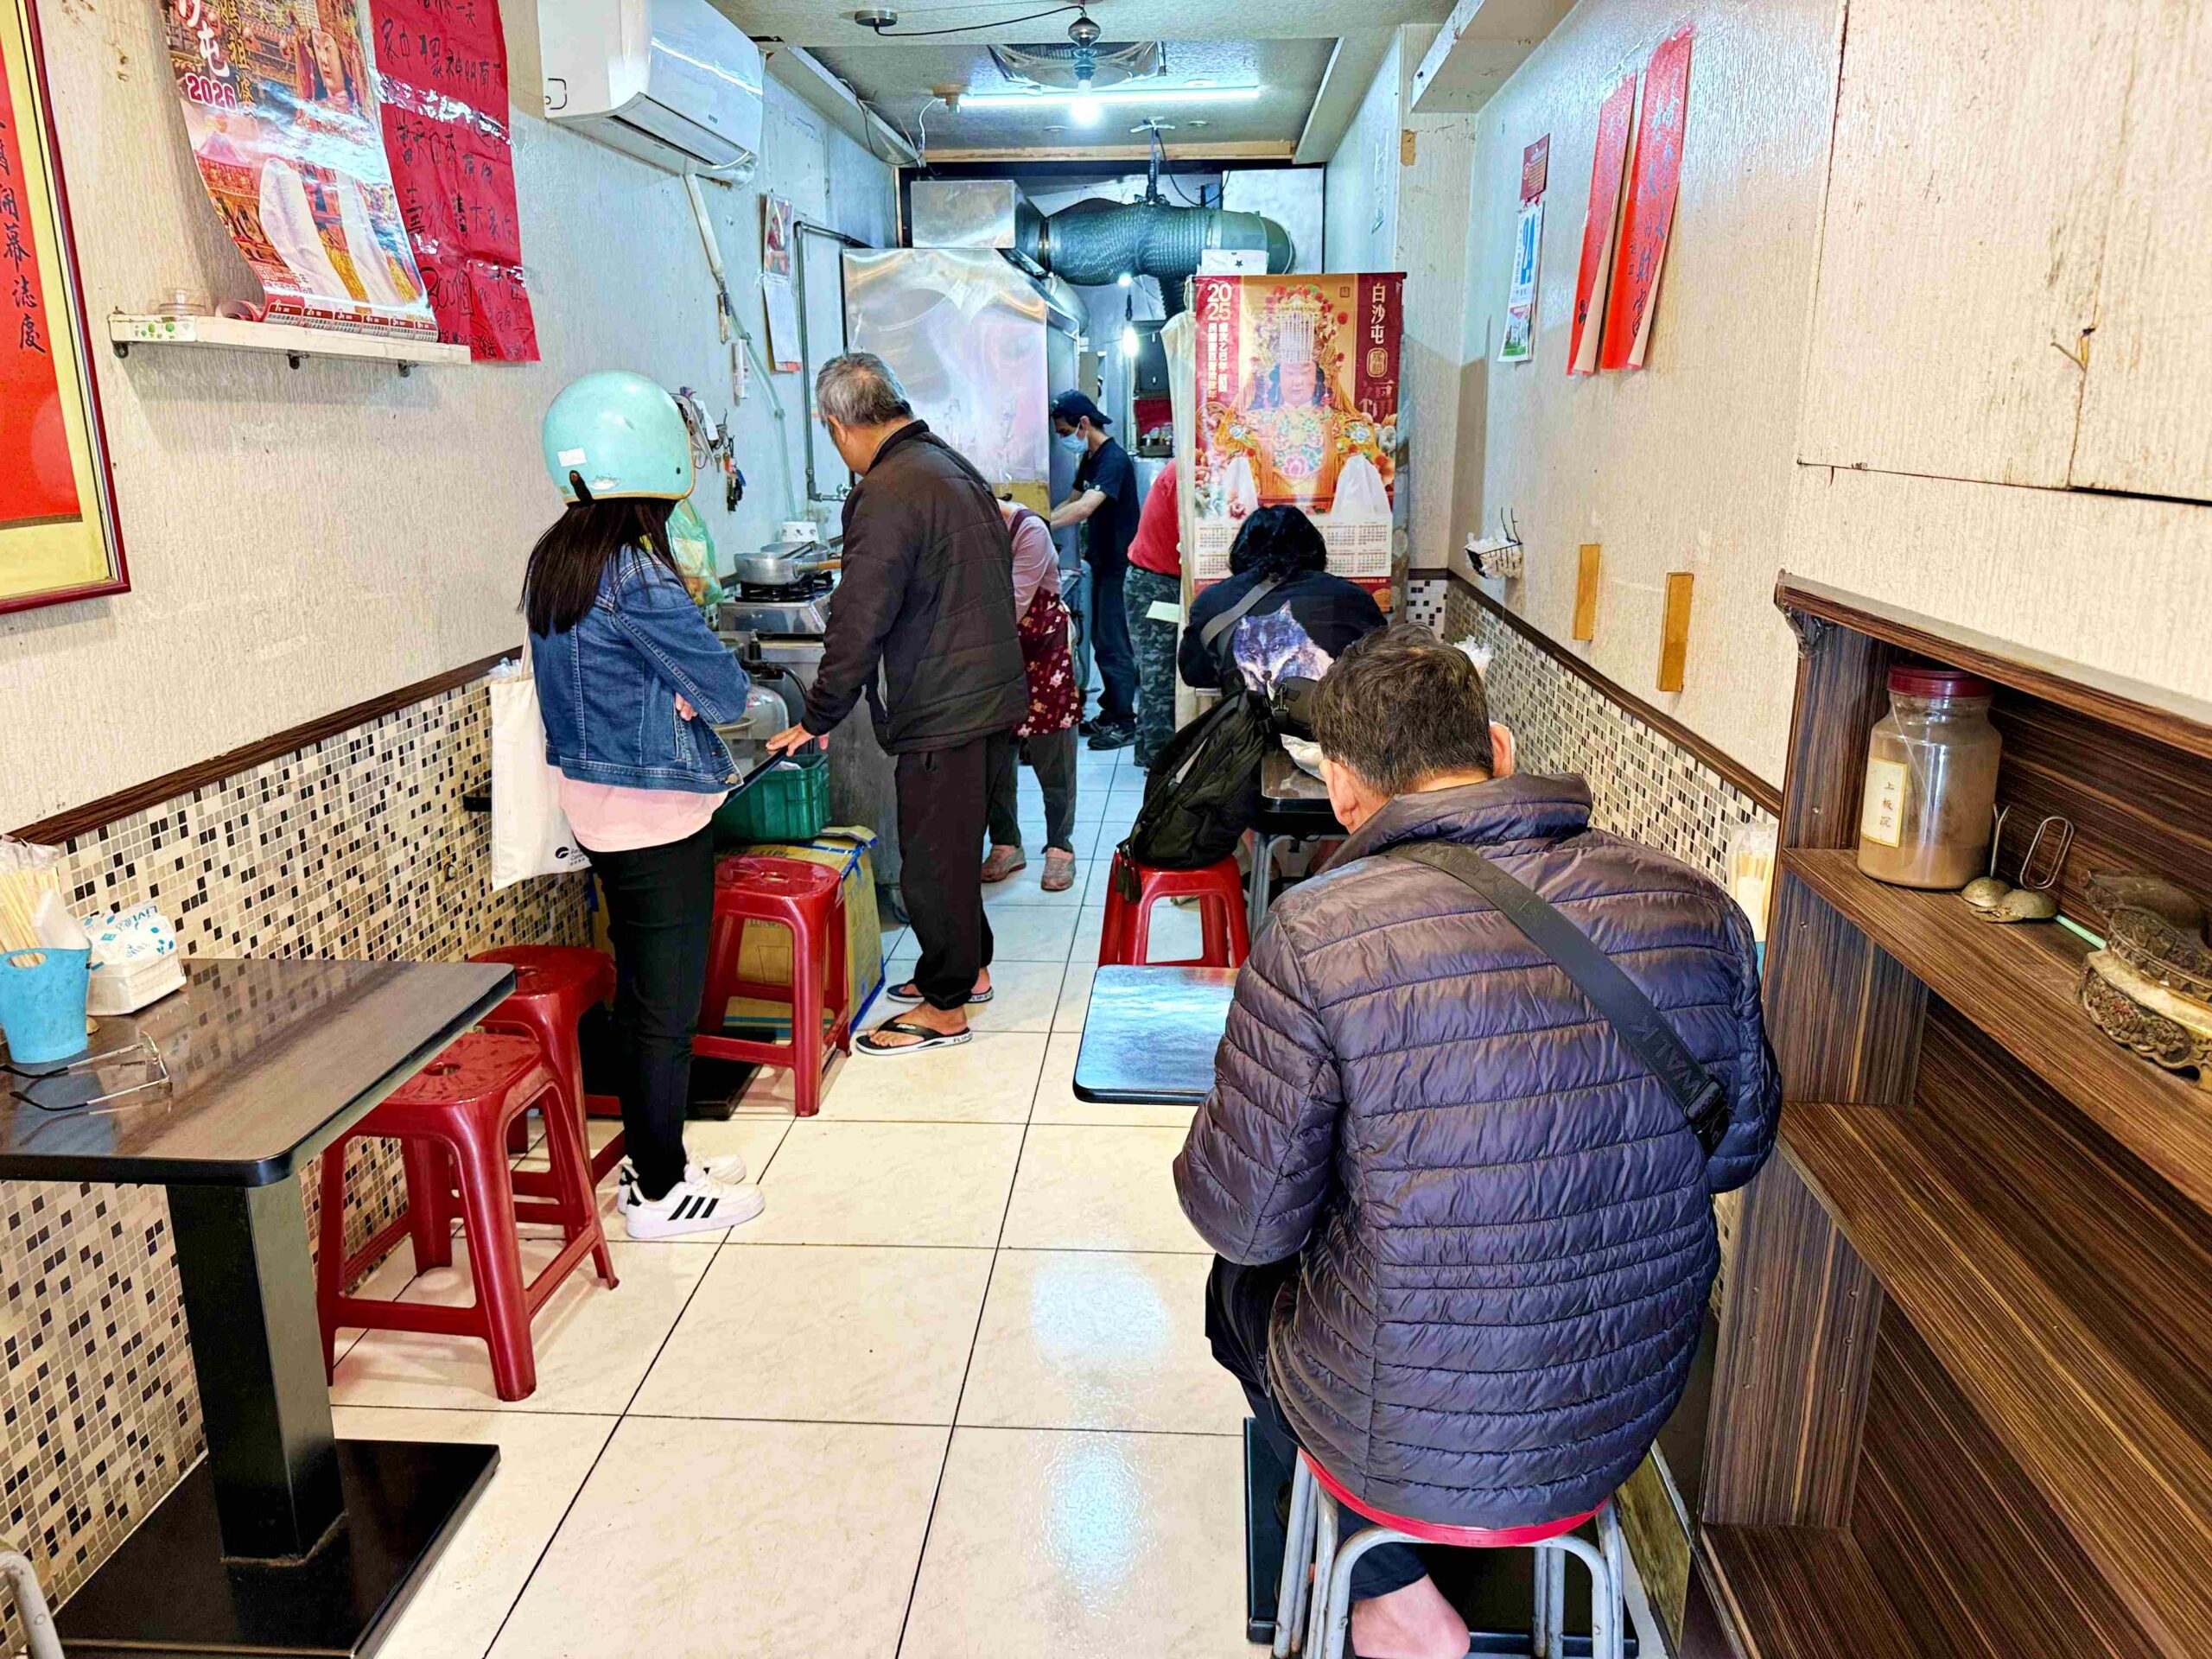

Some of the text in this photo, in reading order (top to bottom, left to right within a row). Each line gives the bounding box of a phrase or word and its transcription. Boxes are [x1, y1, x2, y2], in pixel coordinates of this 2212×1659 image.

[185, 73, 238, 112] 2026
[0, 122, 46, 353] 開幕誌慶
[1370, 283, 1386, 345] 白沙屯
